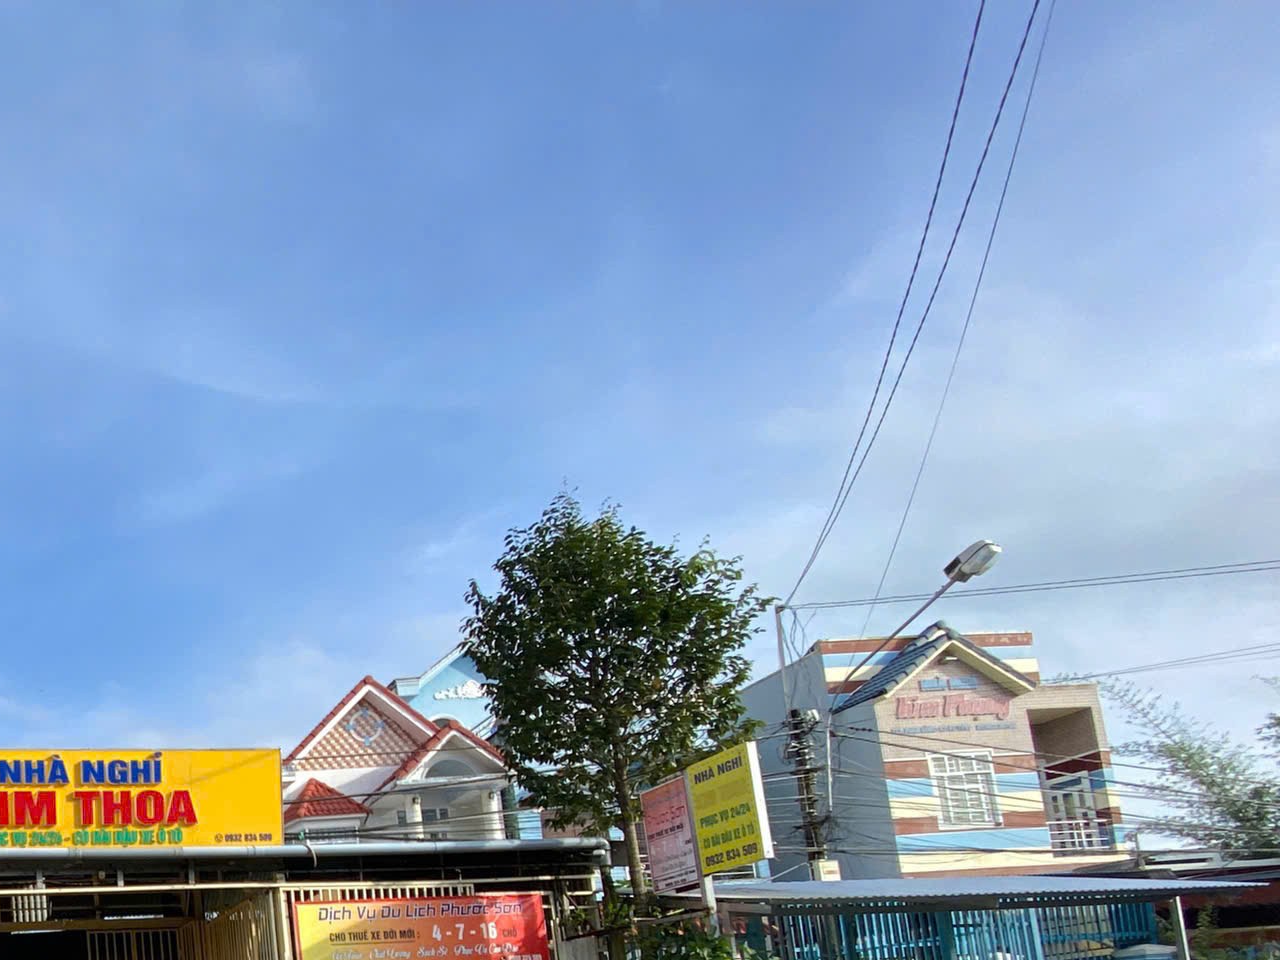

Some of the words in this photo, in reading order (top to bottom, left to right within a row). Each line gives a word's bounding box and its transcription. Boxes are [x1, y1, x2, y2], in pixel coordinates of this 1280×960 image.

[79, 752, 162, 785] NGHỈ
[694, 765, 715, 785] NHÀ
[717, 752, 743, 775] NGHỈ
[70, 789, 199, 828] THOA
[318, 906, 352, 924] Dịch
[357, 905, 376, 922] Vụ
[381, 905, 401, 918] Du
[406, 903, 436, 920] Lịch
[329, 932, 346, 942] CHO
[349, 929, 368, 941] THUÊ
[370, 931, 381, 940] XE
[432, 924, 442, 941] 4
[455, 923, 465, 940] 7
[480, 922, 498, 939] 16
